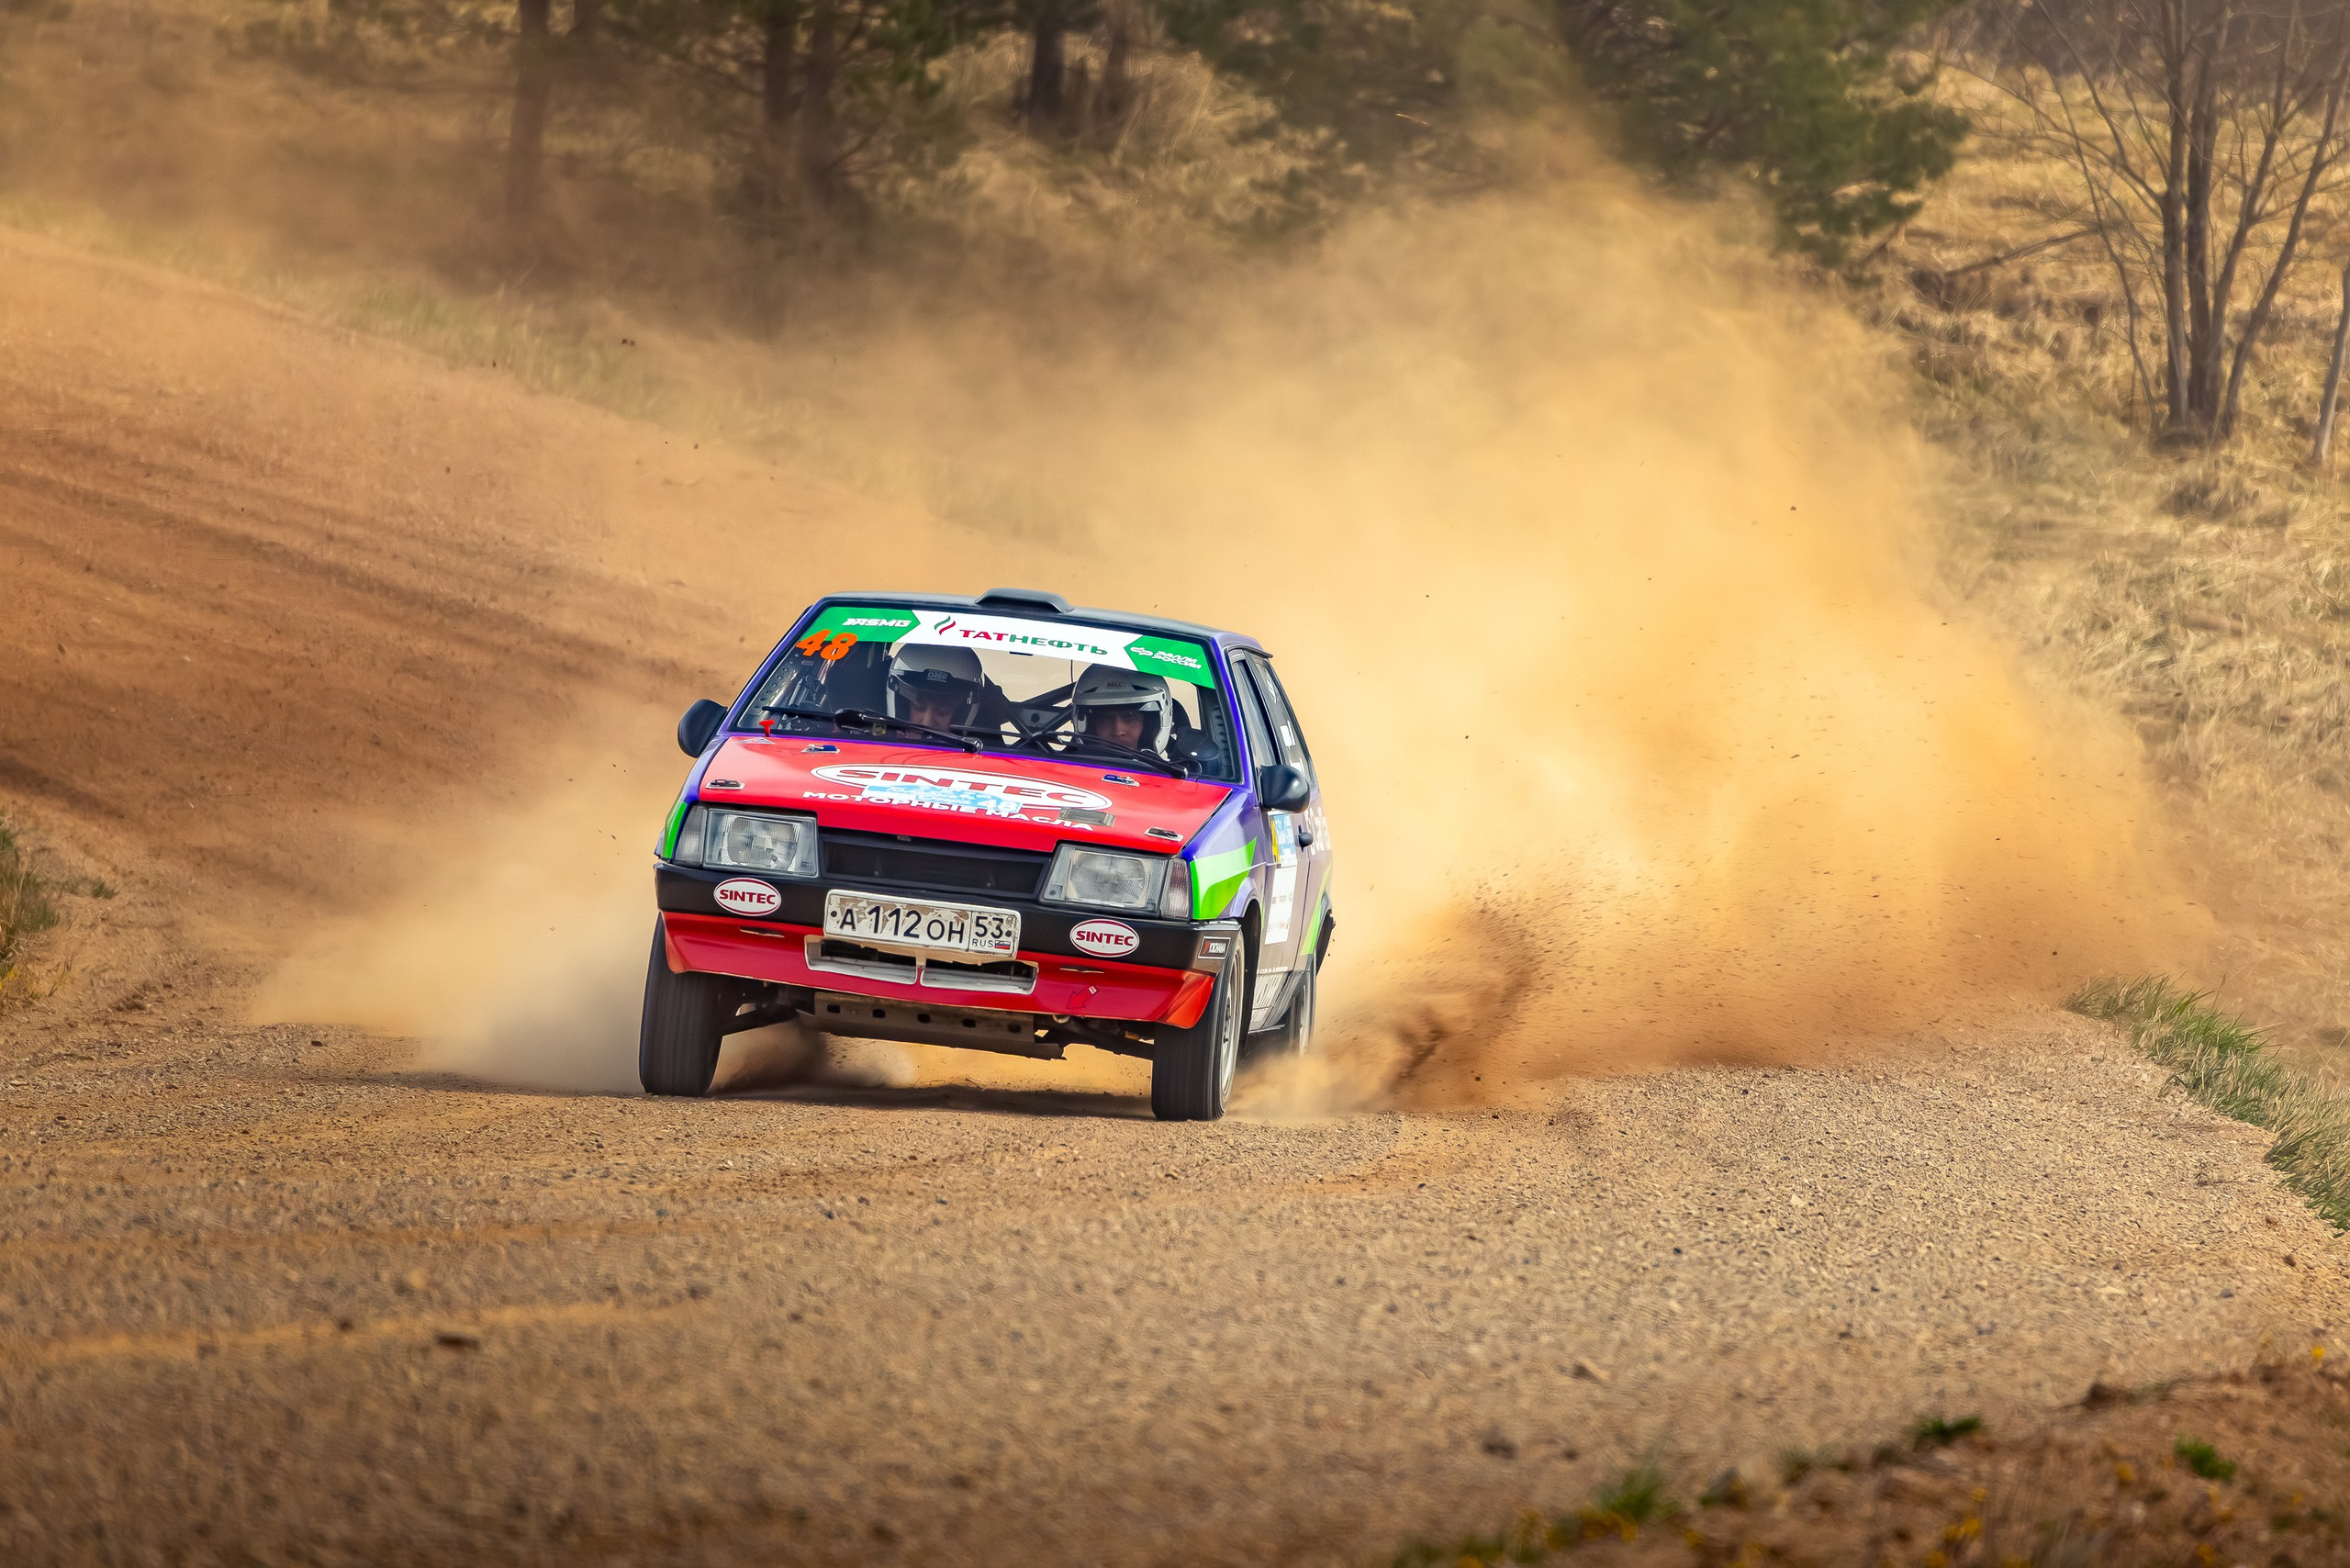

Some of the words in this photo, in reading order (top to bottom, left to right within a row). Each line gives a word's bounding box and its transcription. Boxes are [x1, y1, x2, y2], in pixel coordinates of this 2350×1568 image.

[795, 629, 858, 661] 48
[958, 629, 1108, 655] ТАТНЕФТЬ
[835, 769, 1088, 805] SINTEC
[802, 790, 980, 814] МОТОРНЫЕ
[986, 810, 1094, 832] МАСЛА
[976, 799, 1018, 812] 48
[719, 889, 777, 905] SINTEC
[974, 915, 1004, 939] 53
[1075, 930, 1135, 946] SINTEC
[971, 938, 994, 948] RUS
